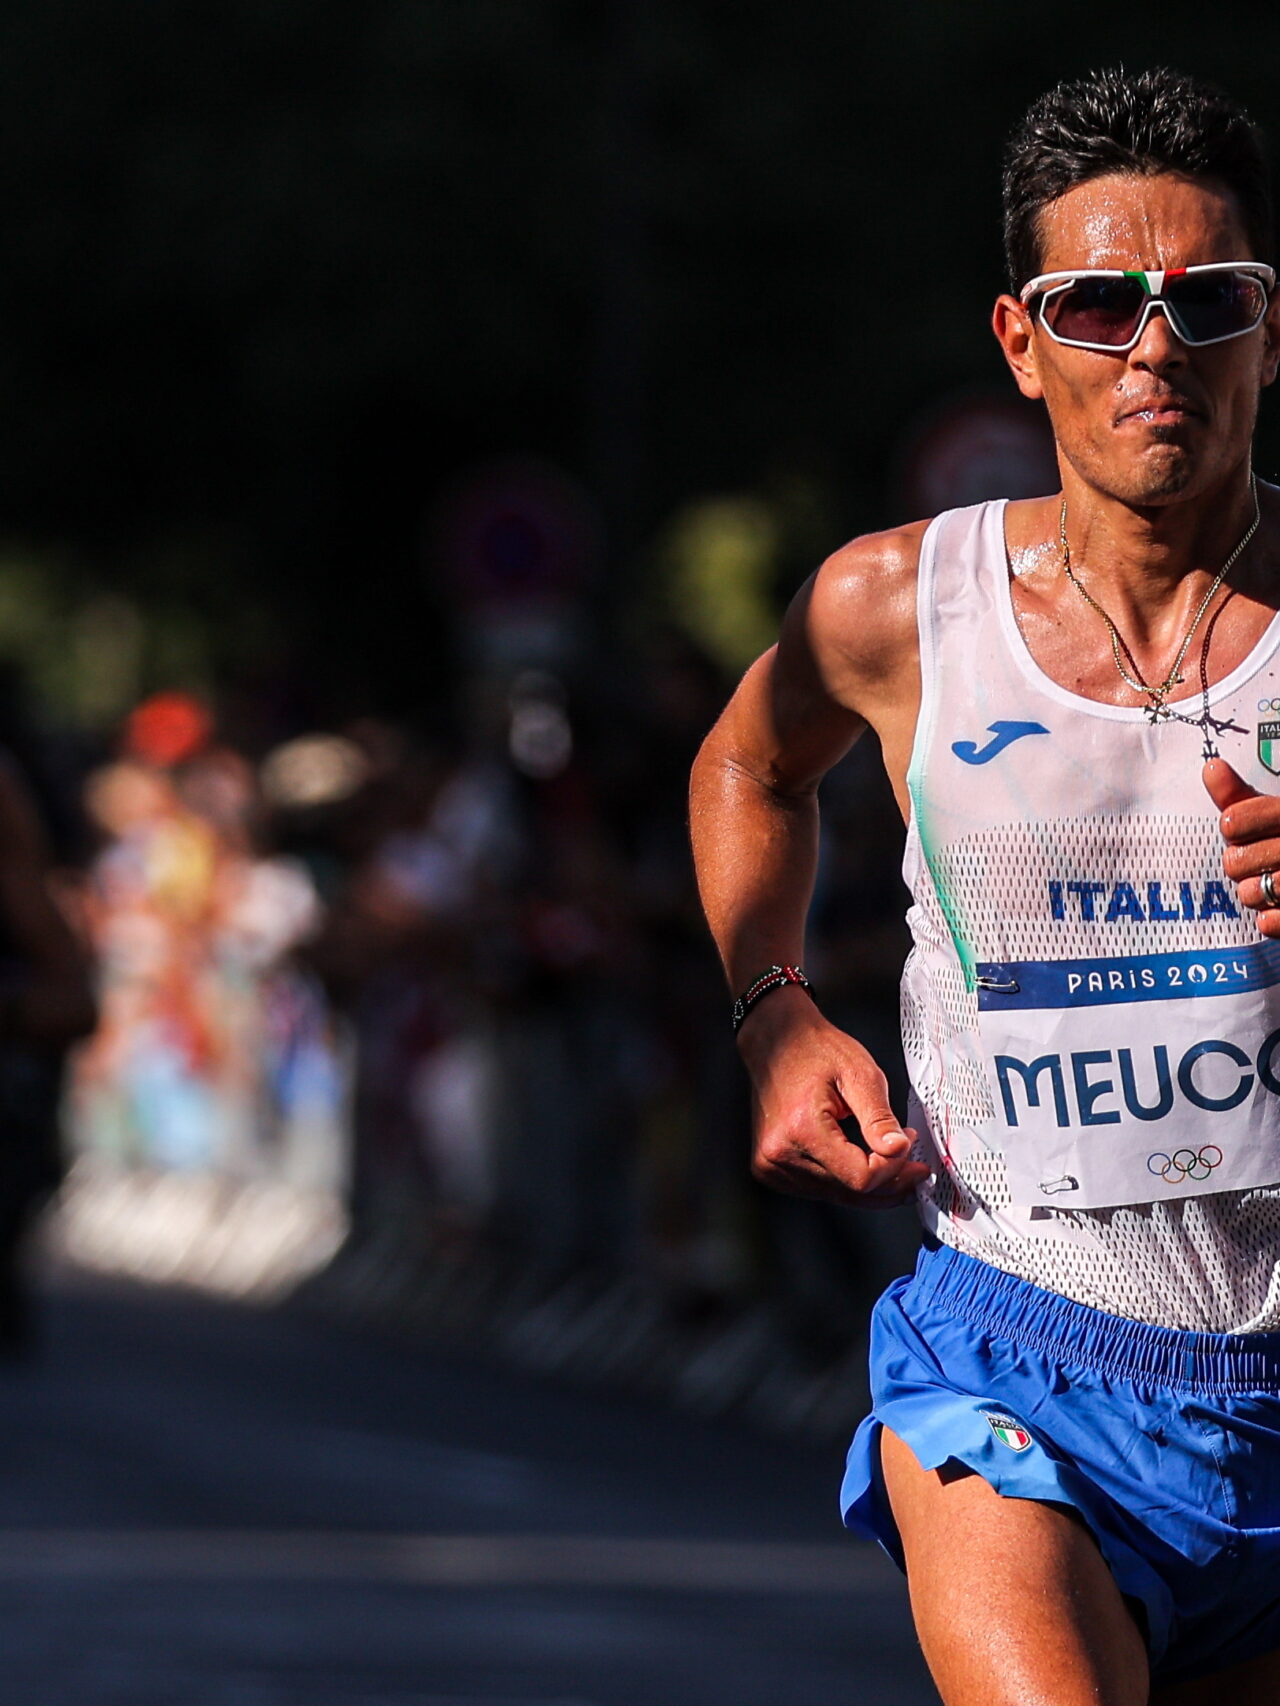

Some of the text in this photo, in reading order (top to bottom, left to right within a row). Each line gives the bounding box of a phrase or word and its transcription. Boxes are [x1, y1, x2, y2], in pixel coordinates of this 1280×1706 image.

[1049, 880, 1240, 921] ITALIA
[1068, 961, 1248, 993] PARIS 2024
